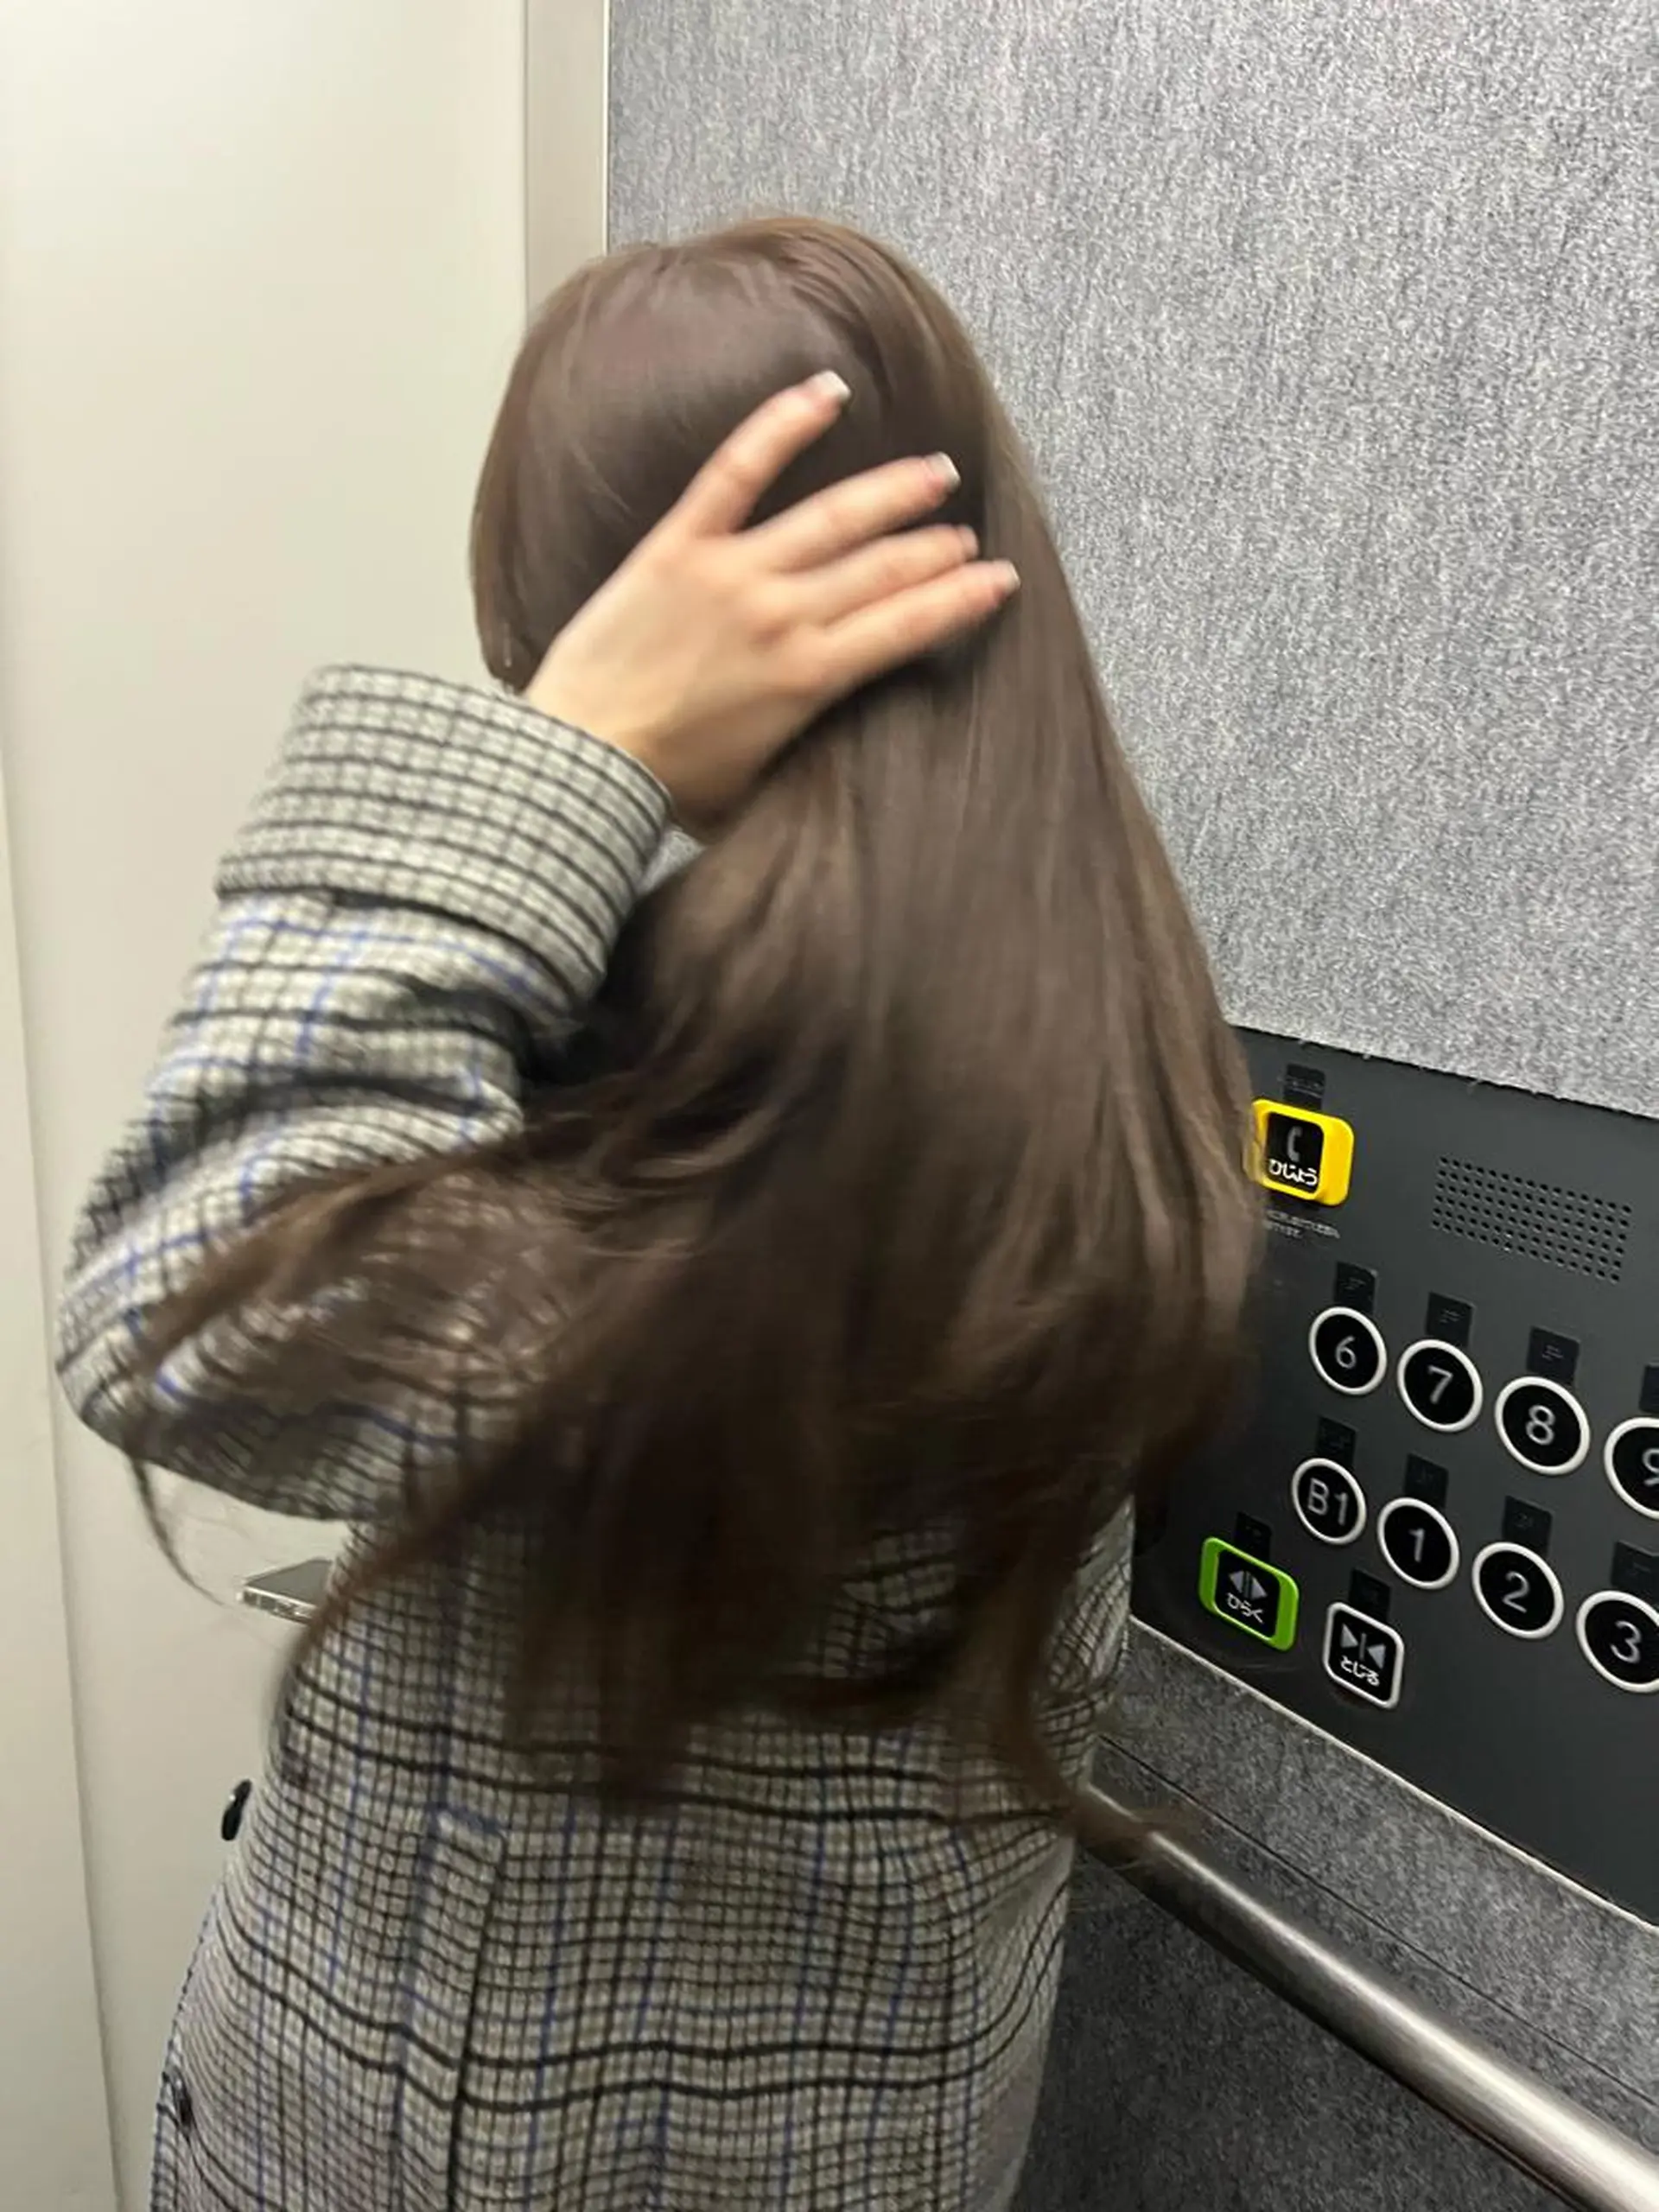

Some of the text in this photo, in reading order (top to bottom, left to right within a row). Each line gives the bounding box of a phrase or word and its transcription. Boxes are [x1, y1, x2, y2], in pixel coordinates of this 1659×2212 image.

[1268, 1158, 1319, 1187] ひじょう
[1335, 1336, 1357, 1370] 6
[1428, 1365, 1453, 1404] 7
[1526, 1404, 1555, 1446] 8
[1306, 1478, 1348, 1526] B1
[1408, 1528, 1425, 1563] 1
[1226, 1592, 1266, 1624] ひらく
[1502, 1570, 1530, 1614] 2
[1610, 1619, 1642, 1664] 3
[1340, 1655, 1380, 1687] とじる
